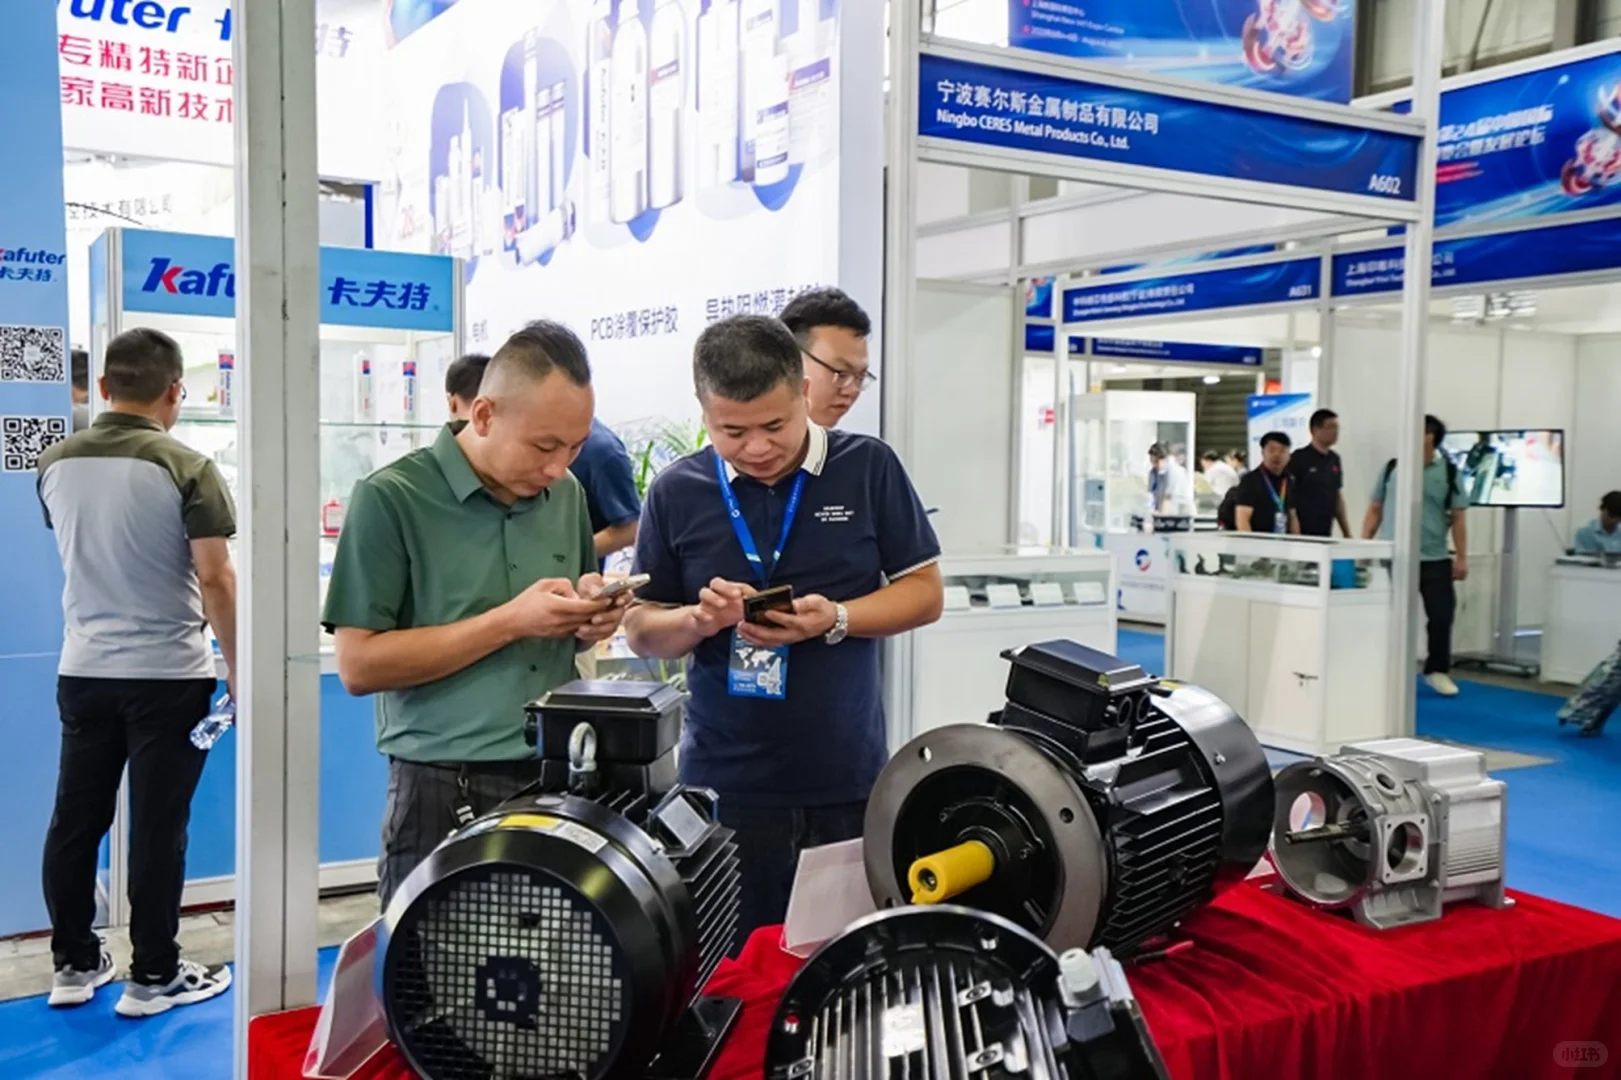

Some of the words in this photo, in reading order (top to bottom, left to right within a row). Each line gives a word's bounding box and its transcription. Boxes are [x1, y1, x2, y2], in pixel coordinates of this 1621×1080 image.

[937, 80, 1159, 135] 宁波赛尔斯金属制品有限公司
[936, 109, 978, 129] Ningbo
[978, 115, 1012, 133] CERES
[1014, 121, 1044, 138] Metal
[1045, 126, 1089, 144] Products
[1368, 174, 1401, 194] A602
[0, 247, 66, 265] afuter
[327, 277, 431, 310] 卡夫特
